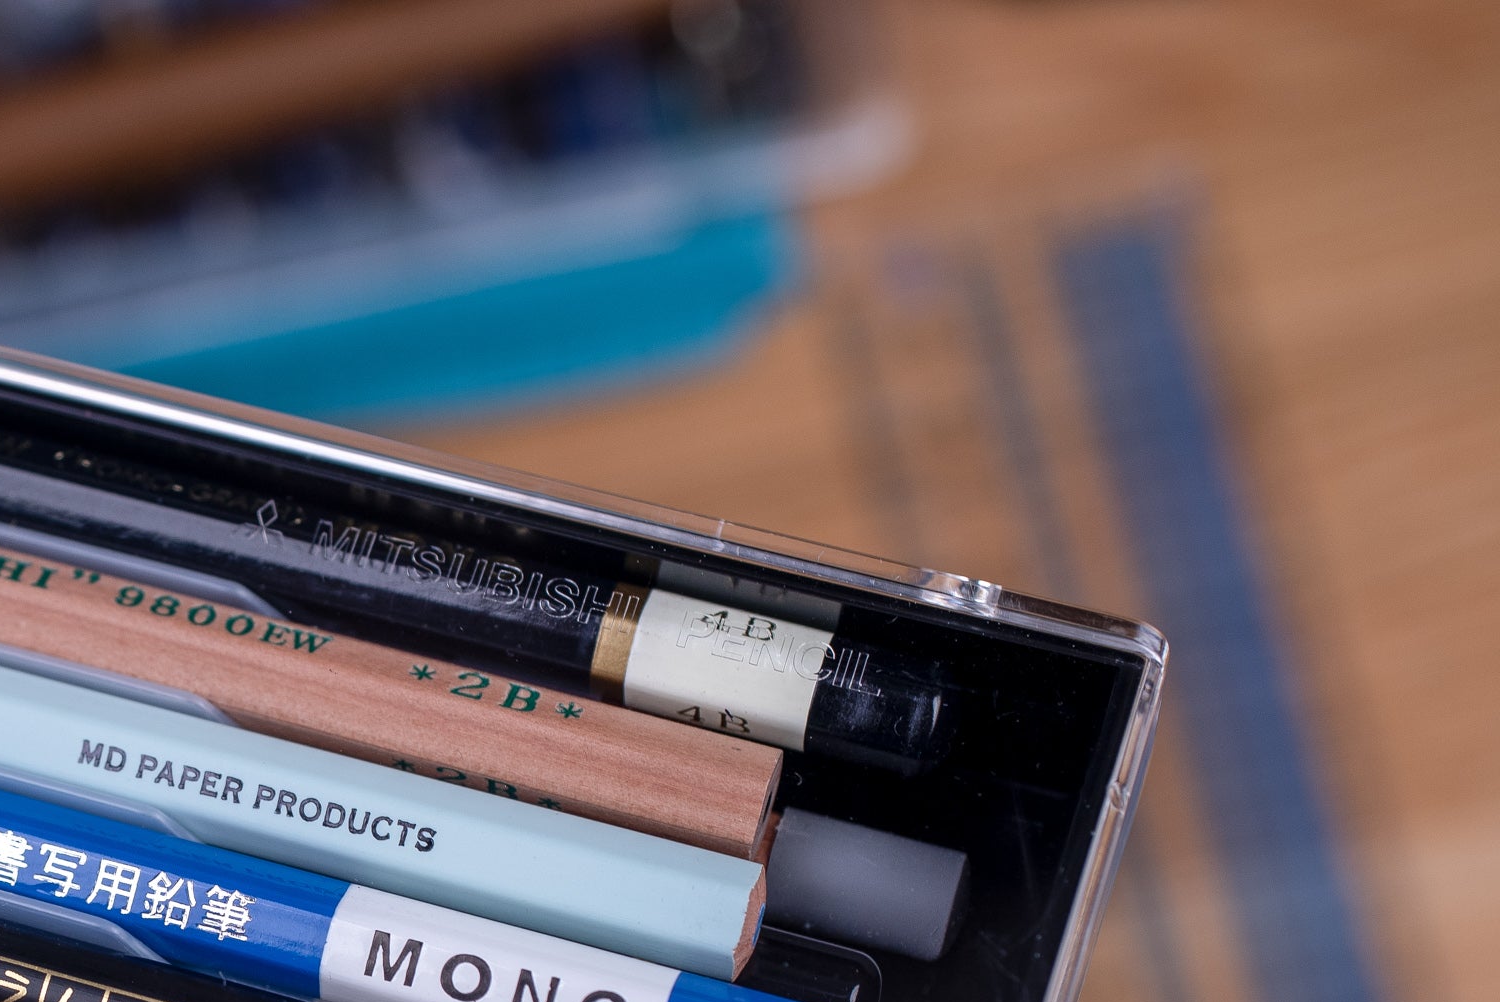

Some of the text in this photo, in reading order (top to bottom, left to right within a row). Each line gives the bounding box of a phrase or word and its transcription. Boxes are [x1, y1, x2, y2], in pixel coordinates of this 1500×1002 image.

[114, 585, 334, 655] 9800EW
[309, 518, 882, 698] MITSUBISHI PENCIL
[698, 609, 778, 643] 4B
[676, 704, 752, 735] 4B
[77, 738, 438, 854] MD PAPER PRODUCTS
